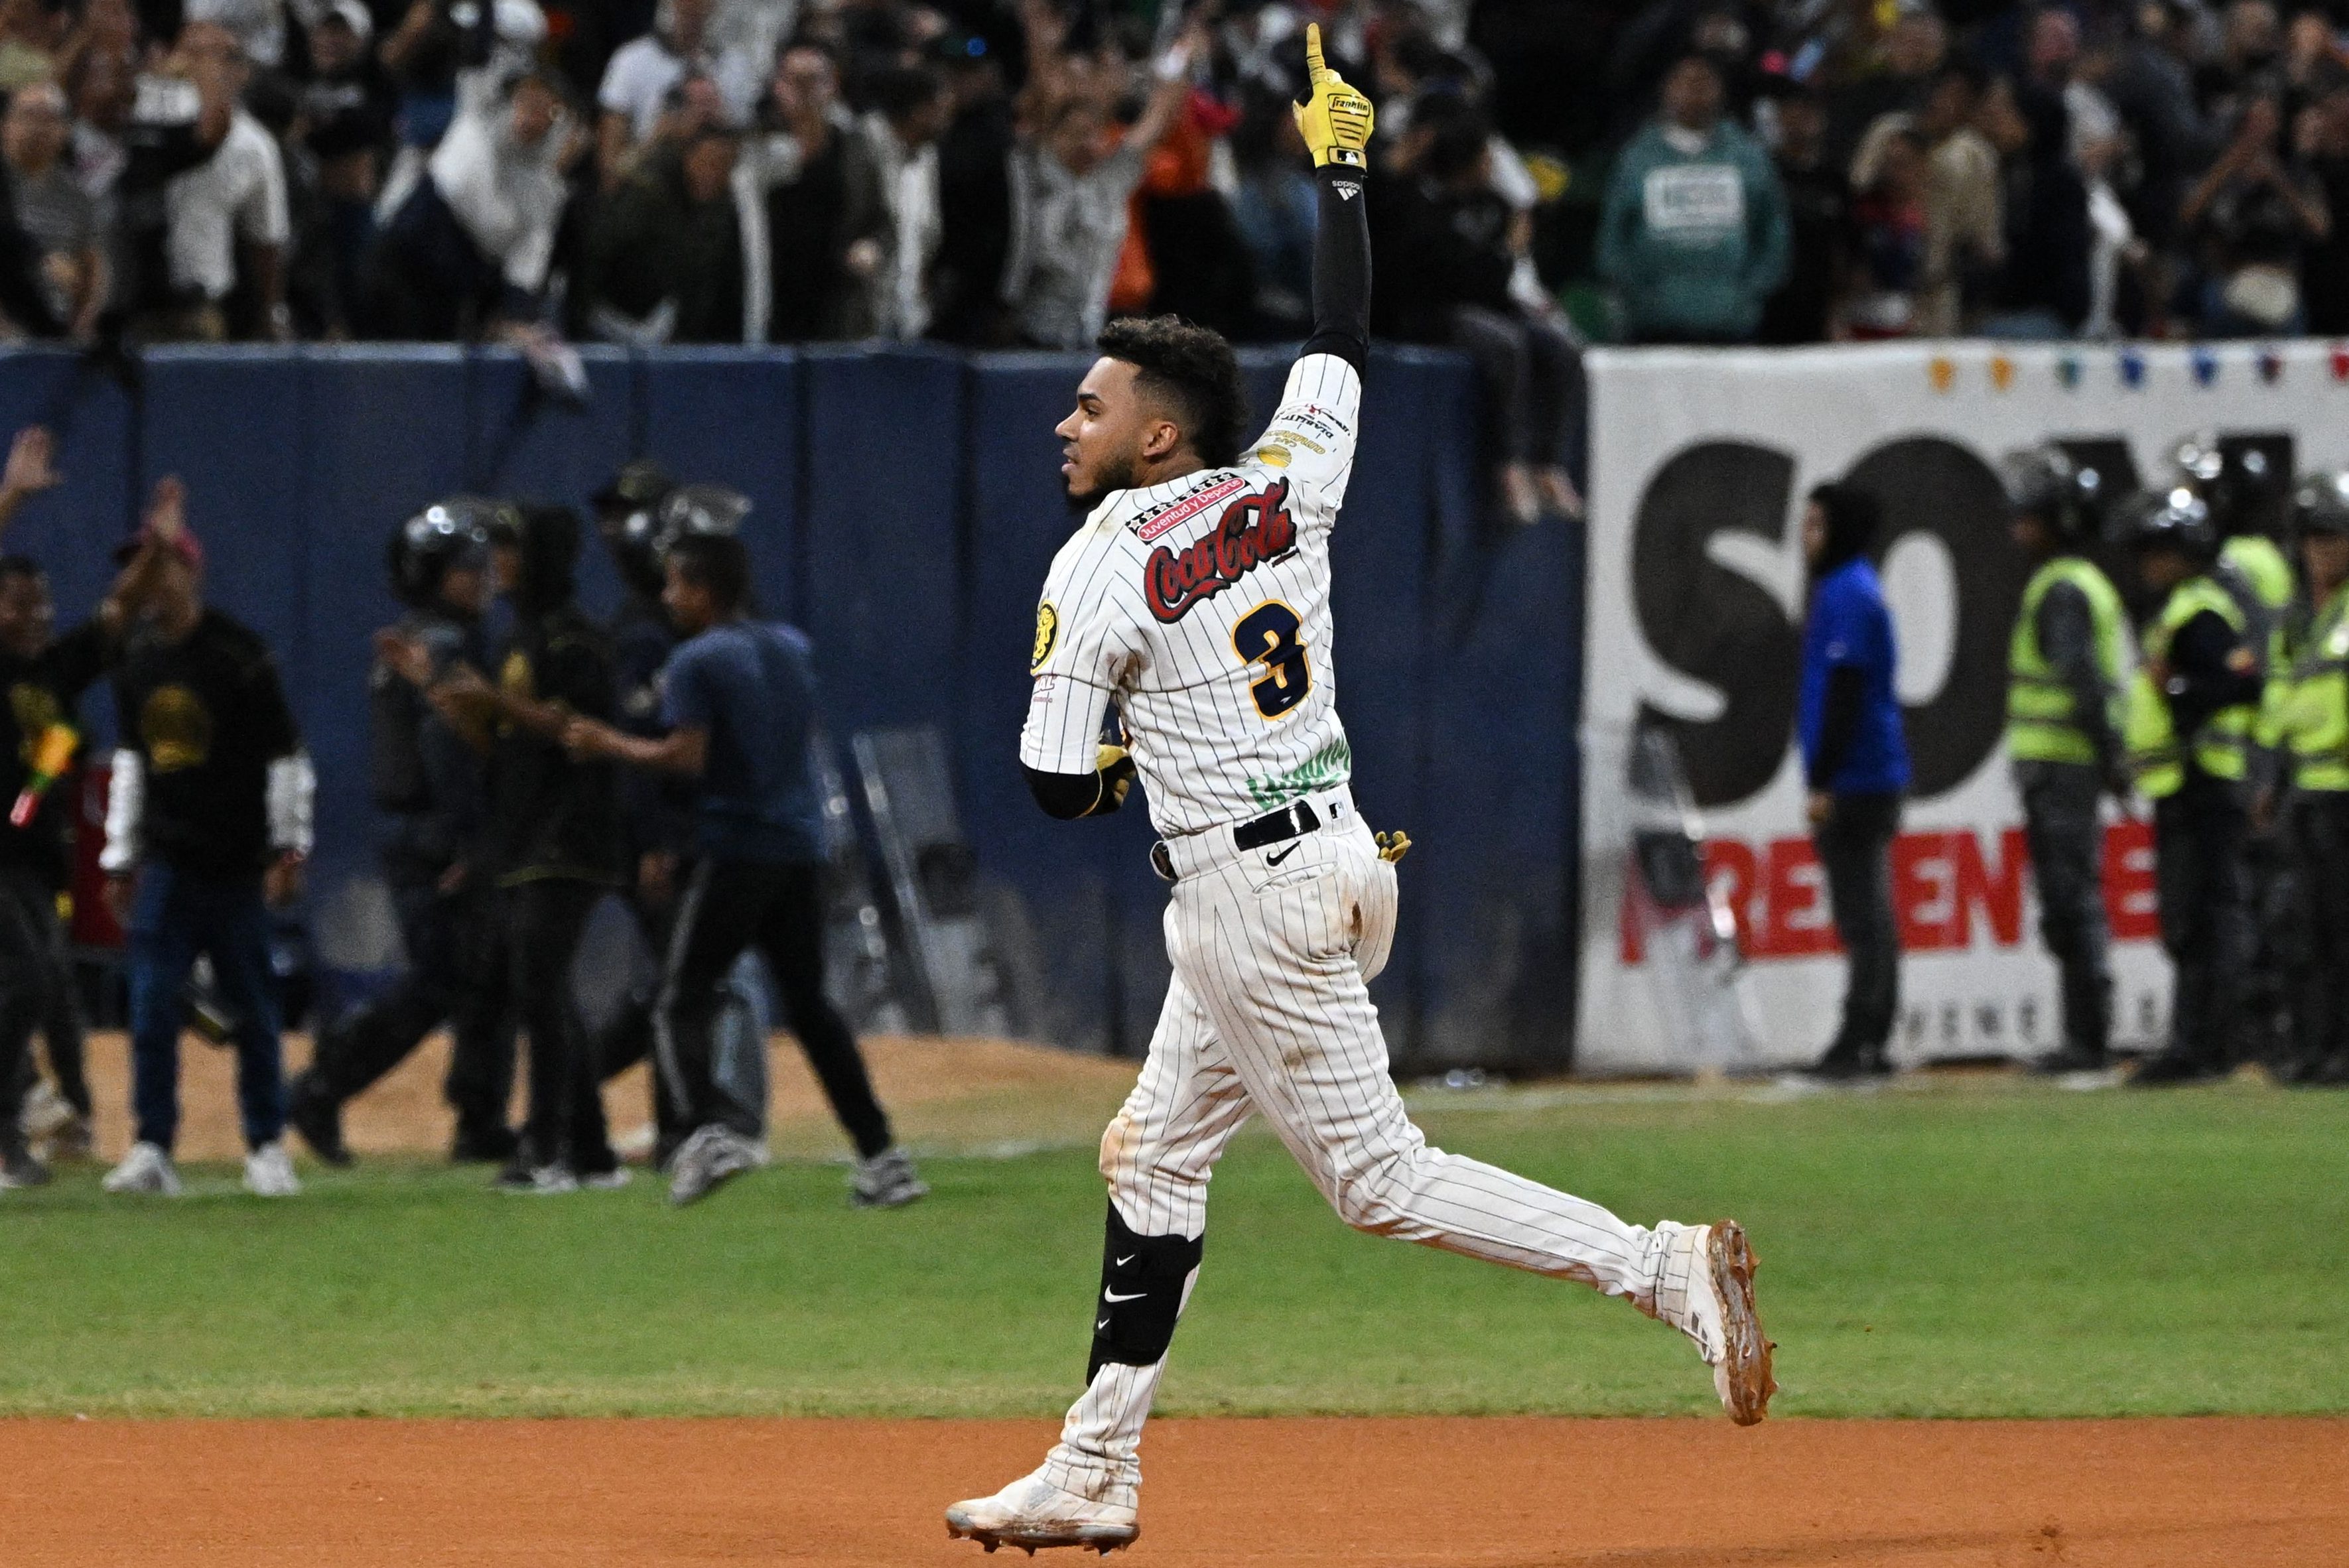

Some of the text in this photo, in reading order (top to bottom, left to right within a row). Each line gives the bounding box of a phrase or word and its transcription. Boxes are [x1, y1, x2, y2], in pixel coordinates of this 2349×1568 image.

[1331, 180, 1360, 190] adidas
[1140, 478, 1242, 539] Juventud y Deporte
[1231, 598, 1313, 722] 3
